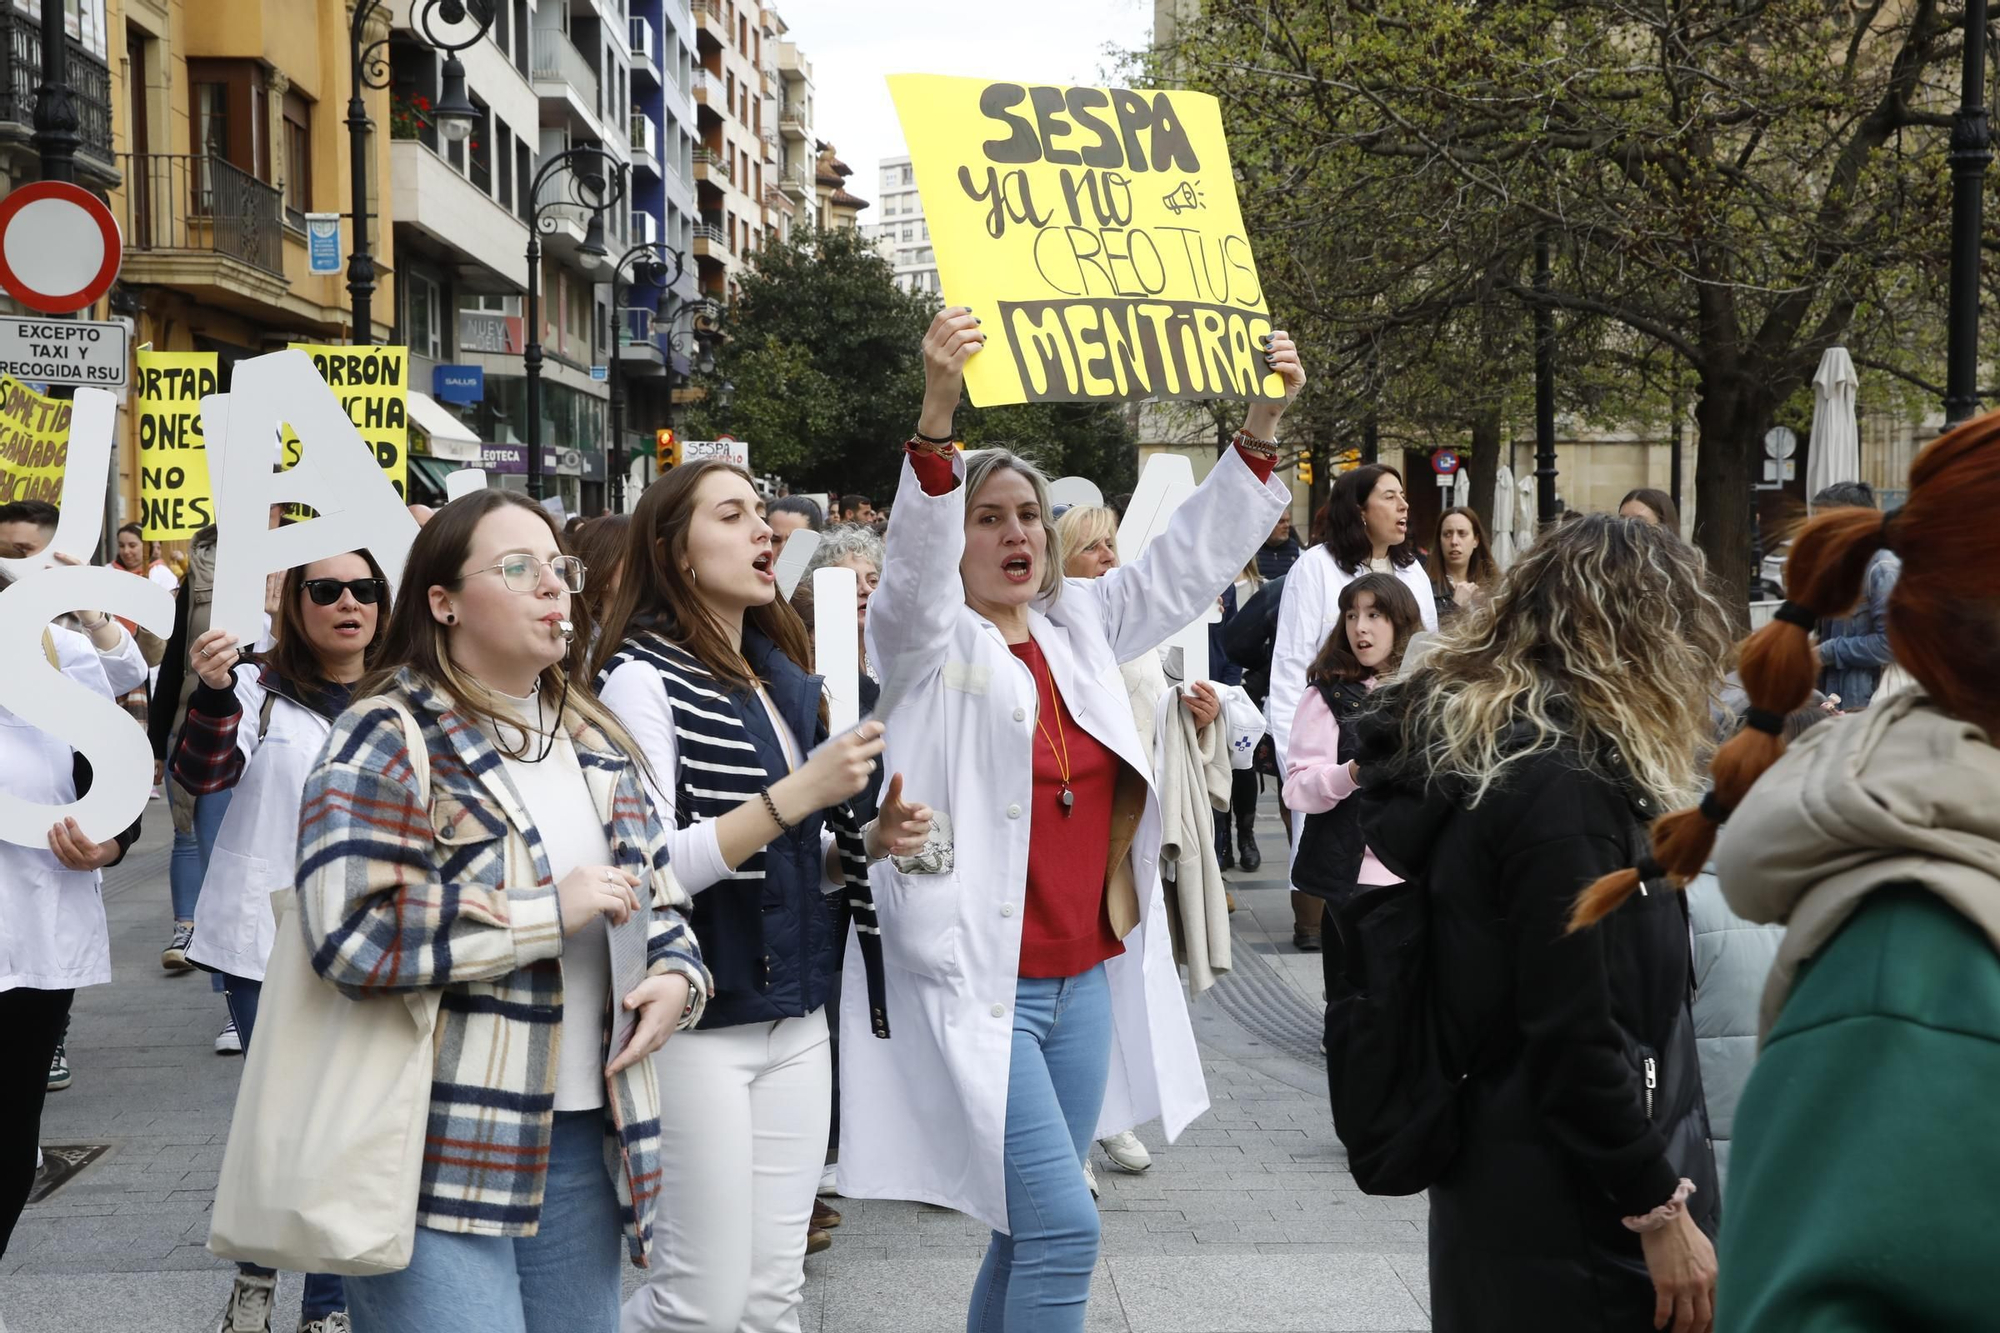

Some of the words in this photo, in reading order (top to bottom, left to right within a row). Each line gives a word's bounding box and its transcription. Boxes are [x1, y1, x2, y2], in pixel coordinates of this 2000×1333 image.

[980, 83, 1200, 173] SESPA
[958, 165, 1054, 239] ya
[1059, 168, 1132, 227] no
[1034, 226, 1165, 297] CREO
[1154, 226, 1261, 306] TUS
[18, 324, 101, 342] EXCEPTO
[29, 343, 68, 359] TAXI
[78, 346, 88, 360] Y
[0, 361, 82, 379] RECOGIDA
[87, 365, 119, 380] RSU
[445, 378, 477, 386] SALUS
[480, 450, 521, 462] EOTECA
[687, 443, 730, 455] SESPA
[142, 467, 185, 490] NO
